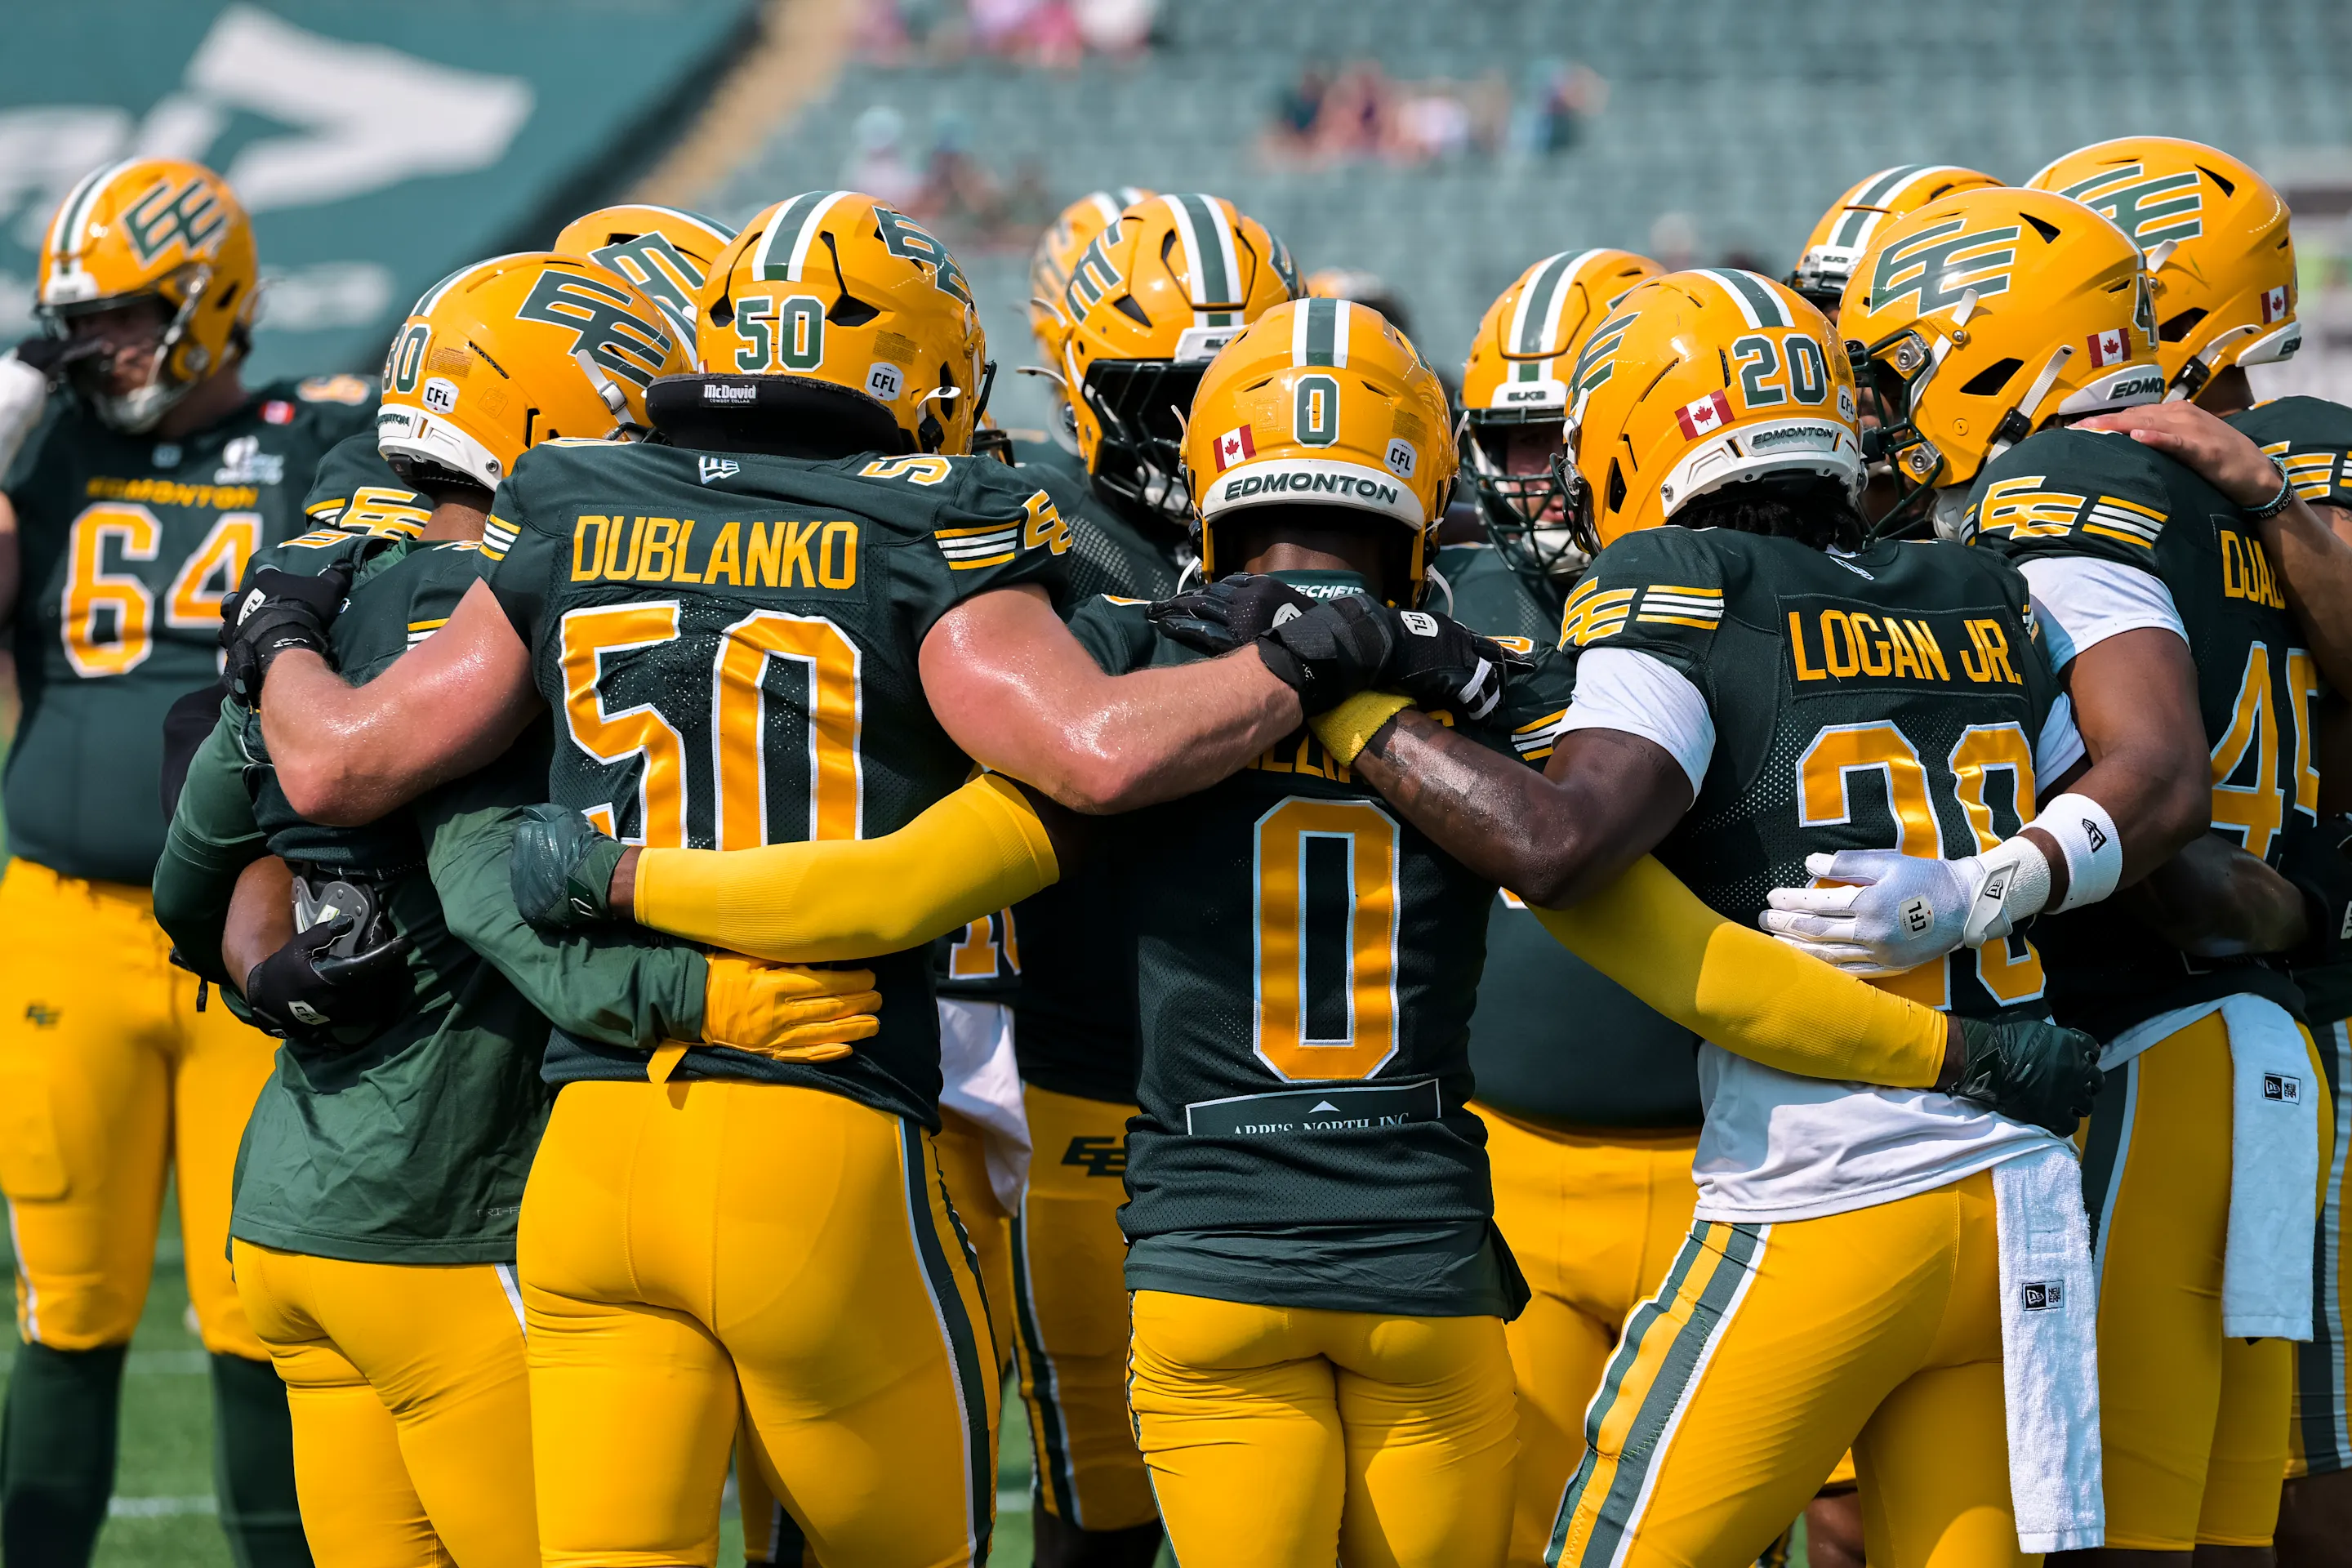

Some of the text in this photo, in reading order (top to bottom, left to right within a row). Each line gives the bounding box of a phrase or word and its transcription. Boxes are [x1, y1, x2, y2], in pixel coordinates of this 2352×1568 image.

[1867, 217, 2022, 319] EE
[514, 268, 673, 390] EE
[735, 295, 826, 374] 50
[425, 385, 450, 407] CFL
[703, 384, 757, 399] McDavid
[871, 372, 896, 394] CFL
[1731, 333, 1829, 410] 20
[1293, 373, 1340, 448] 0
[1750, 426, 1835, 448] EDMONTON
[1223, 471, 1399, 505] EDMONTON
[1389, 447, 1411, 472] CFL
[61, 501, 263, 679] 64
[571, 515, 859, 590] DUBLANKO
[1408, 613, 1428, 632] CFL
[1788, 609, 2024, 686] LOGAN JR.
[558, 600, 863, 853] 50
[1253, 795, 1401, 1084] 0
[1908, 901, 1927, 933] CFL
